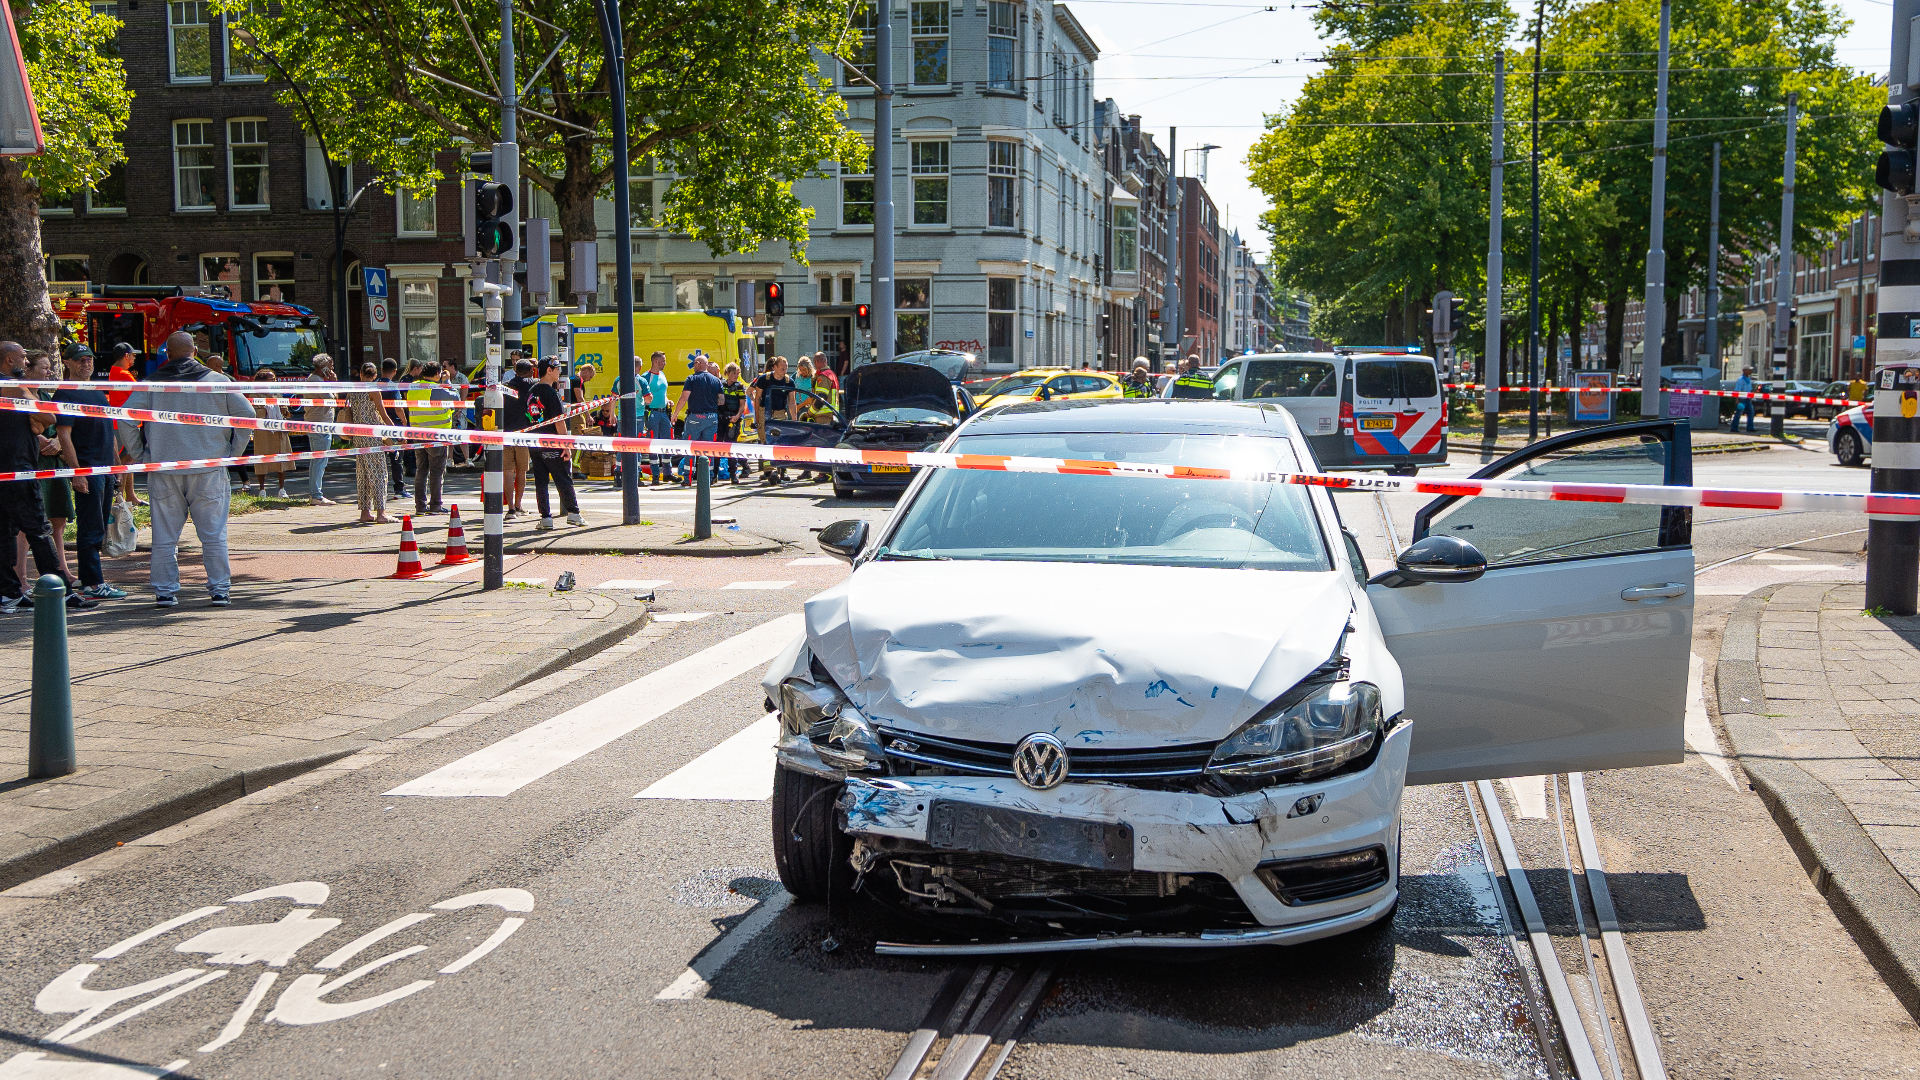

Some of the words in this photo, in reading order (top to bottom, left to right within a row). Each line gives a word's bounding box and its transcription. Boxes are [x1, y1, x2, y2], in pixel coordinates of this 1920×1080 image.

[375, 309, 384, 318] 30
[1246, 471, 1289, 484] NIET
[1295, 474, 1401, 488] BETREDEN
